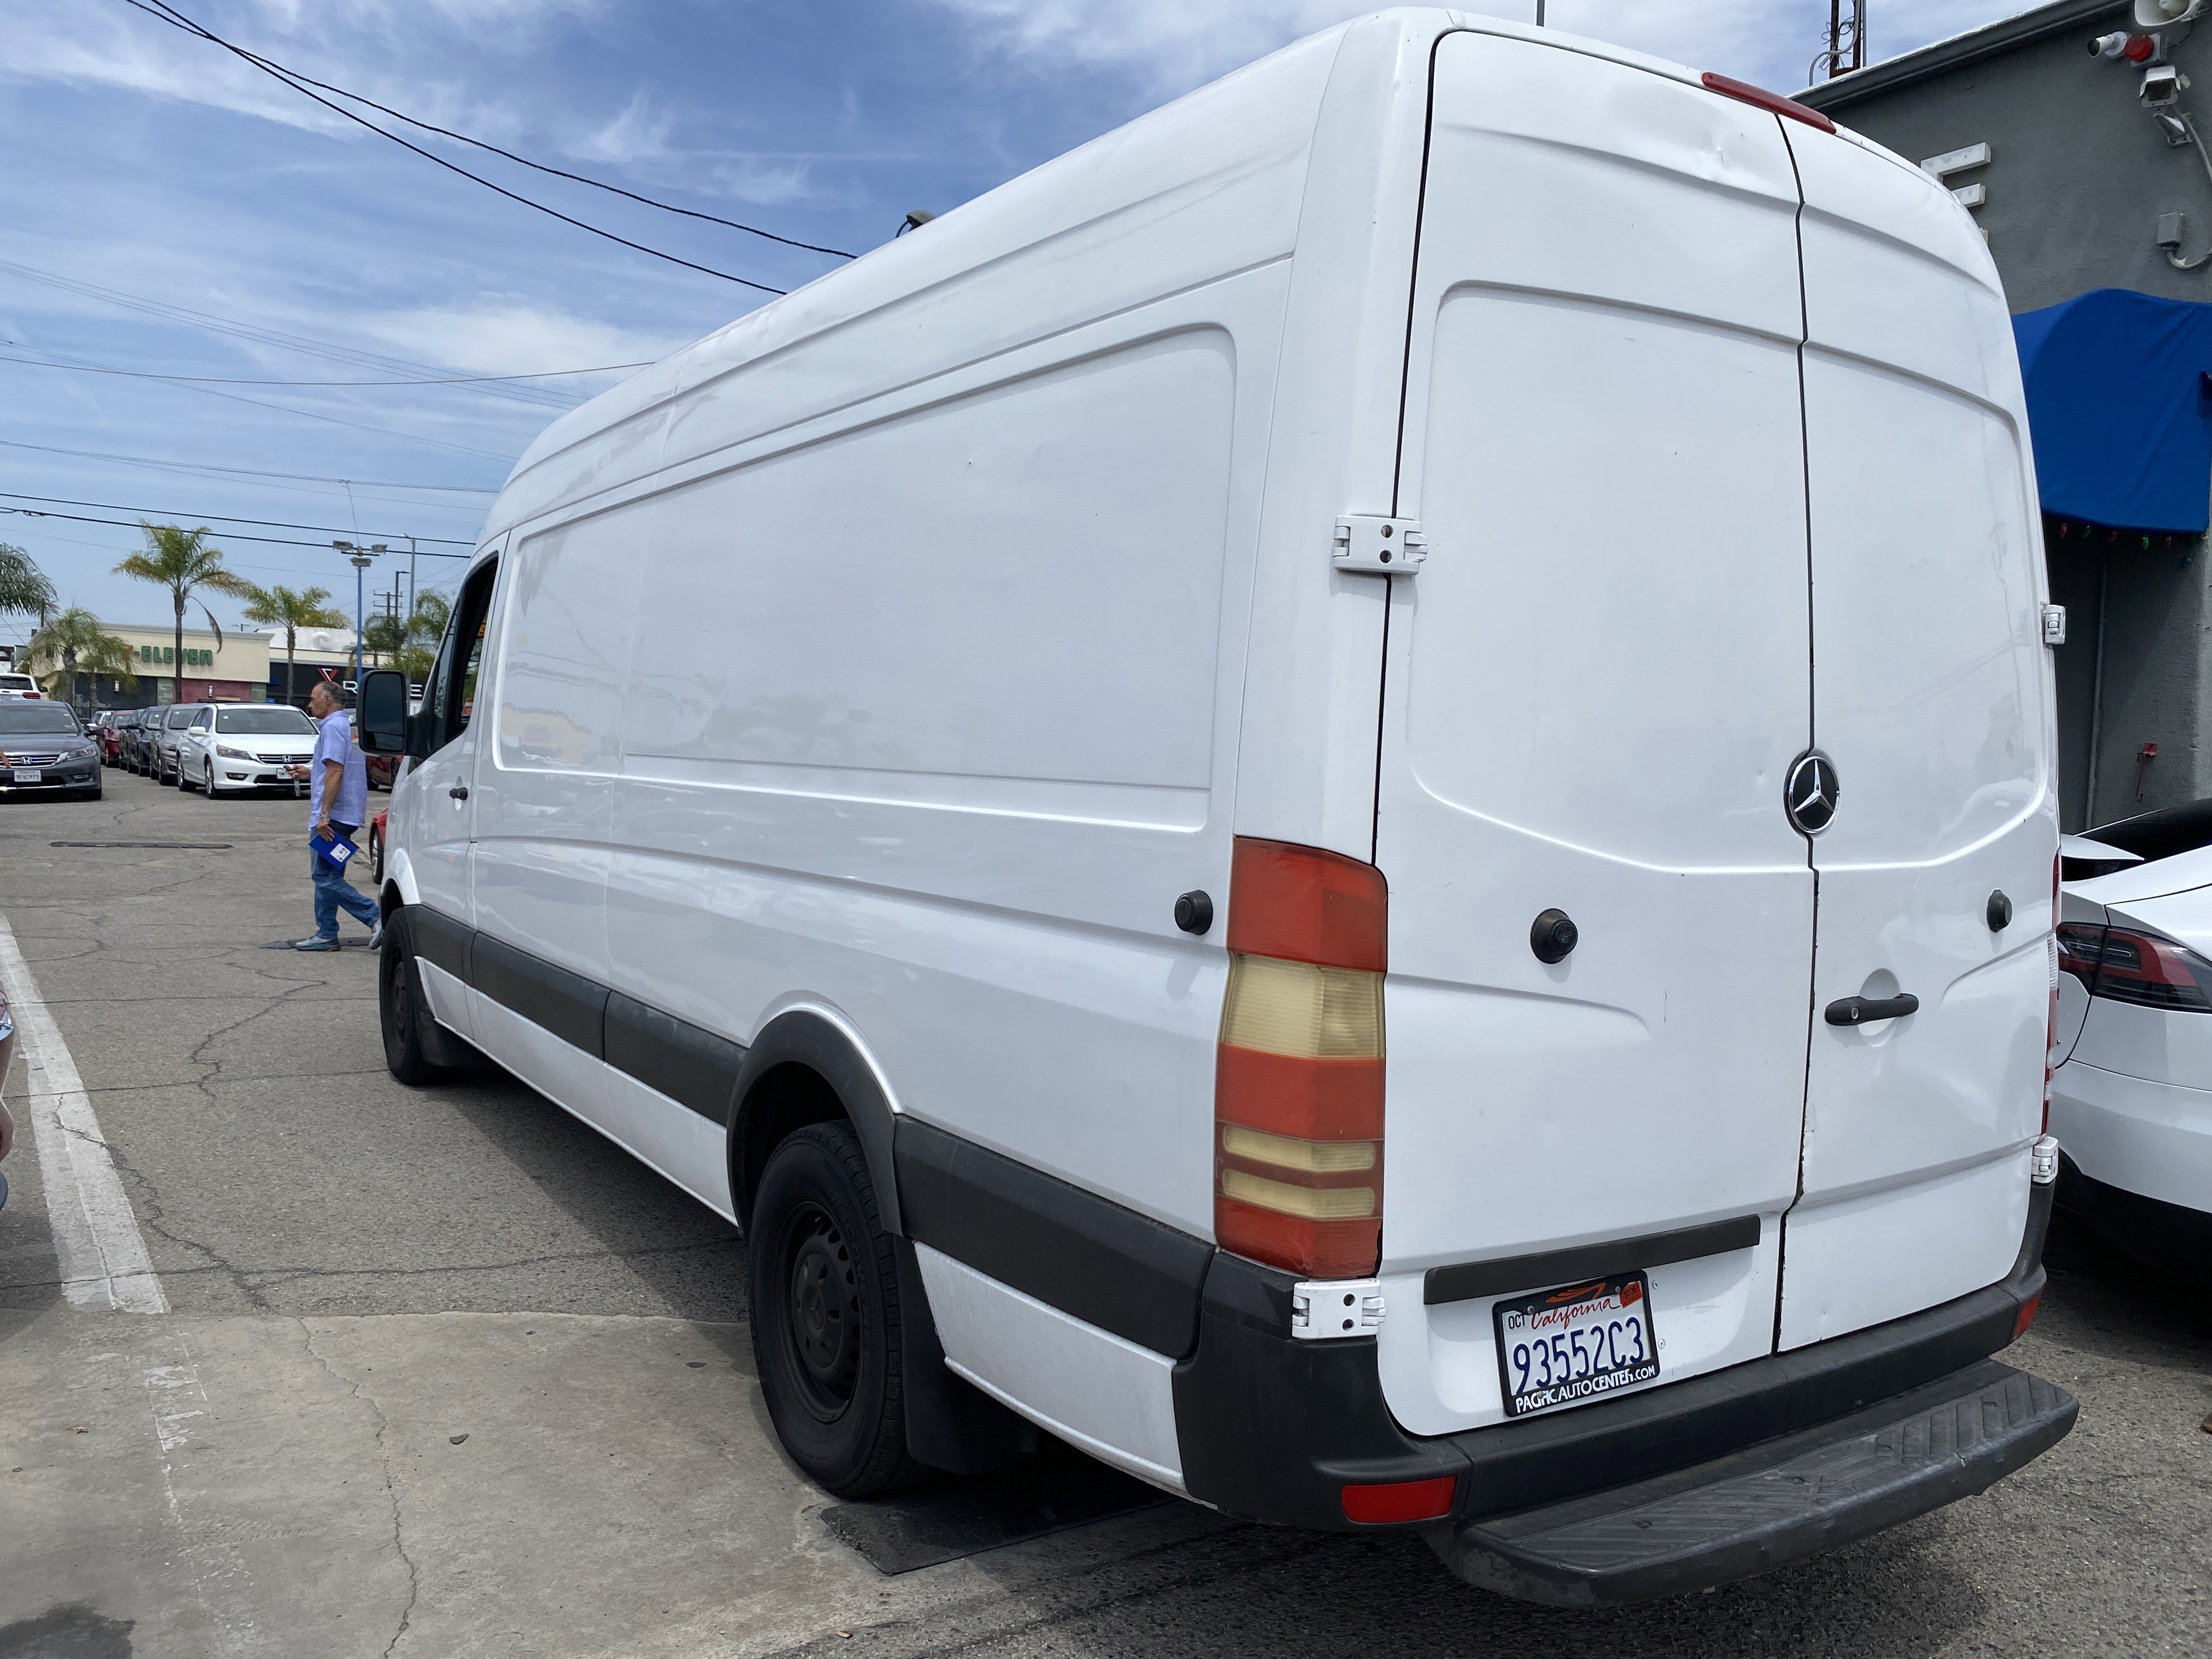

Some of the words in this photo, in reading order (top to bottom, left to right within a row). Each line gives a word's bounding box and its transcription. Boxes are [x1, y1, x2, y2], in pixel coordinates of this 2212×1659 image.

[1508, 1313, 1525, 1329] OCT
[1531, 1297, 1621, 1330] California
[1513, 1317, 1644, 1394] 93552C3
